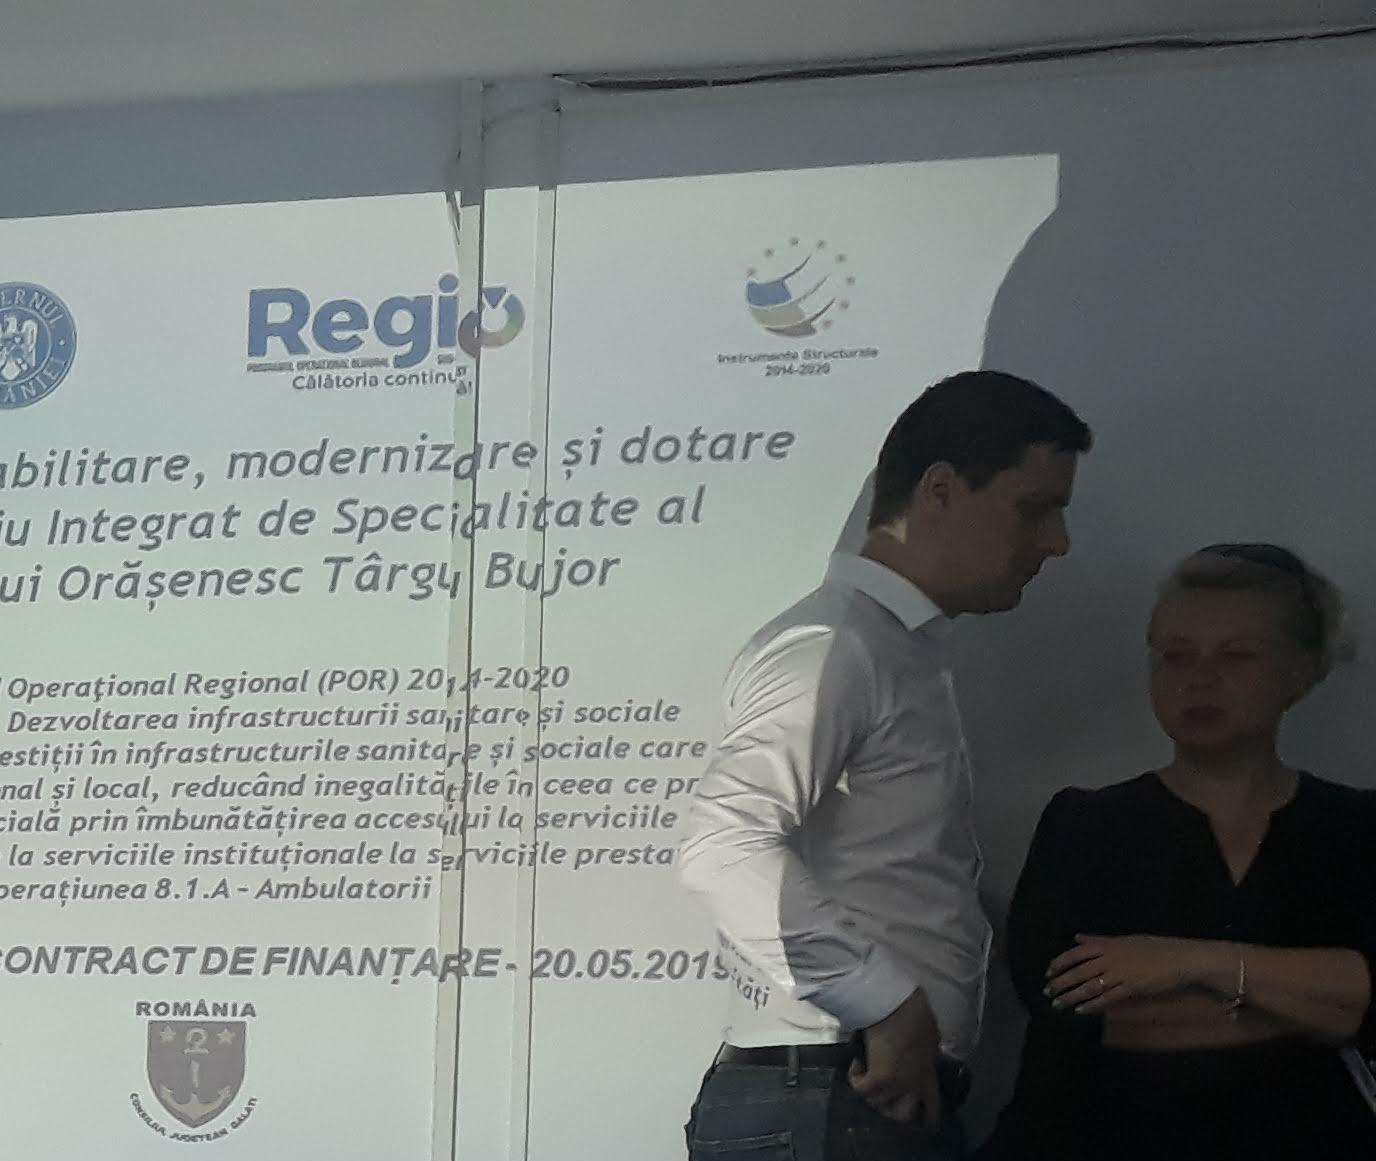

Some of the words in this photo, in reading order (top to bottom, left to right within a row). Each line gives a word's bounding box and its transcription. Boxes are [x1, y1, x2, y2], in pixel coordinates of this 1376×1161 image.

[247, 271, 525, 369] Regio
[227, 432, 538, 481] modernizare
[561, 426, 603, 480] și
[620, 425, 796, 465] dotare
[47, 503, 241, 551] Integrat
[258, 499, 316, 538] de
[332, 489, 639, 543] Specialitate
[657, 485, 706, 526] al
[58, 560, 303, 612] Orășenesc
[324, 552, 461, 600] Târgu
[484, 548, 622, 598] Bujor
[8, 673, 176, 703] Operațional
[184, 670, 309, 700] Regional
[317, 668, 399, 696] (POR)
[406, 665, 569, 697] 2014-2020
[7, 709, 179, 734] Dezvoltarea
[188, 702, 398, 734] infrastructurii
[406, 704, 530, 733] sanitare
[538, 700, 564, 732] și
[574, 699, 680, 723] sociale
[90, 740, 117, 767] în
[125, 738, 348, 769] infrastructurile
[356, 740, 482, 768] sanitare
[489, 737, 514, 767] și
[523, 735, 630, 761] sociale
[638, 740, 708, 760] care
[51, 776, 75, 808] și
[83, 776, 159, 803] local,
[171, 771, 306, 799] reducând
[506, 768, 533, 797] în
[543, 777, 614, 795] ceea
[623, 776, 657, 794] ce
[68, 810, 128, 836] prin
[135, 804, 346, 837] îmbunătățirea
[498, 804, 523, 831] la
[535, 803, 678, 829] serviciile
[8, 844, 33, 867] la
[43, 842, 175, 867] serviciile
[184, 840, 383, 871] instituționale
[389, 840, 416, 865] la
[427, 841, 567, 871] serviciile
[574, 846, 681, 870] presta
[154, 877, 230, 900] 8.1.A
[254, 874, 432, 901] Ambulatorii
[200, 945, 258, 977] DE
[135, 998, 257, 1018] ROMÂNIA
